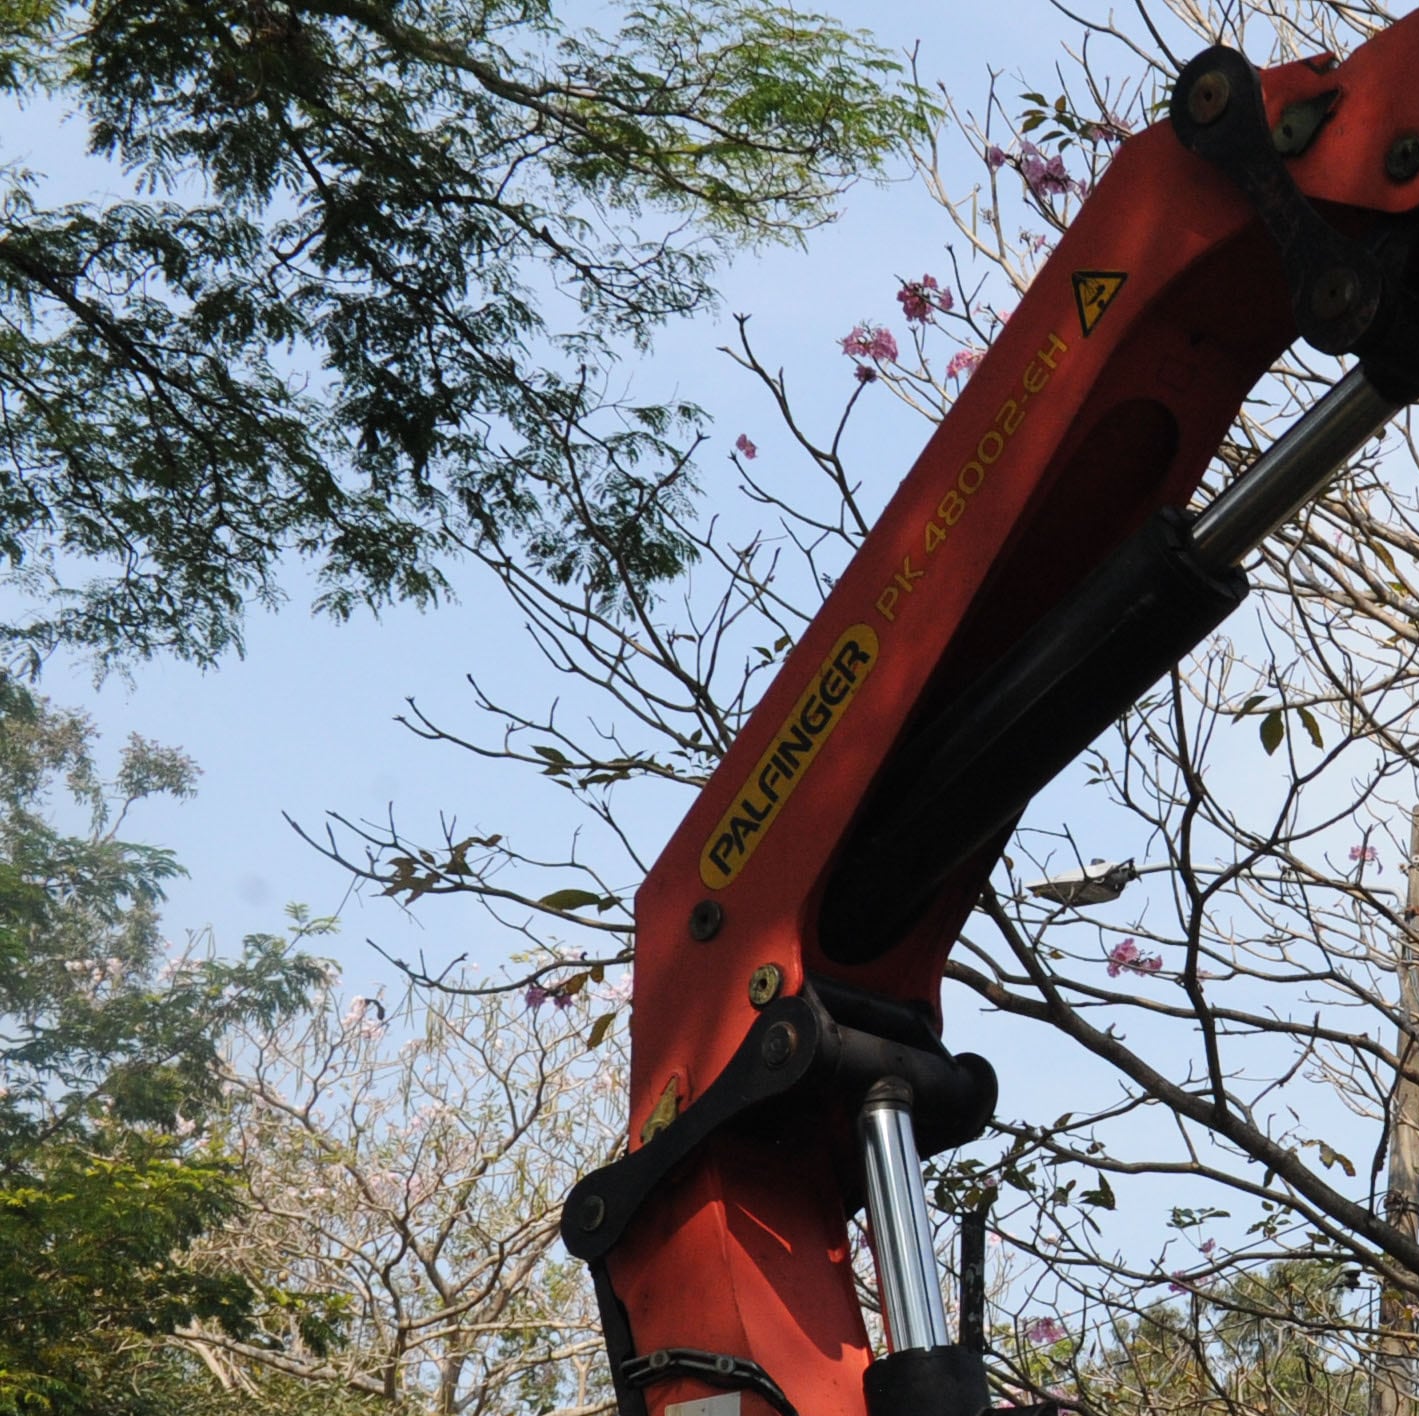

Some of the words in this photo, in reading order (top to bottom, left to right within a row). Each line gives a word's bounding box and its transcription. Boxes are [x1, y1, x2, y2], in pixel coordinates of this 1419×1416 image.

[875, 556, 925, 622] PK
[924, 334, 1068, 553] 48002-EH
[709, 640, 871, 876] PALFINGER
